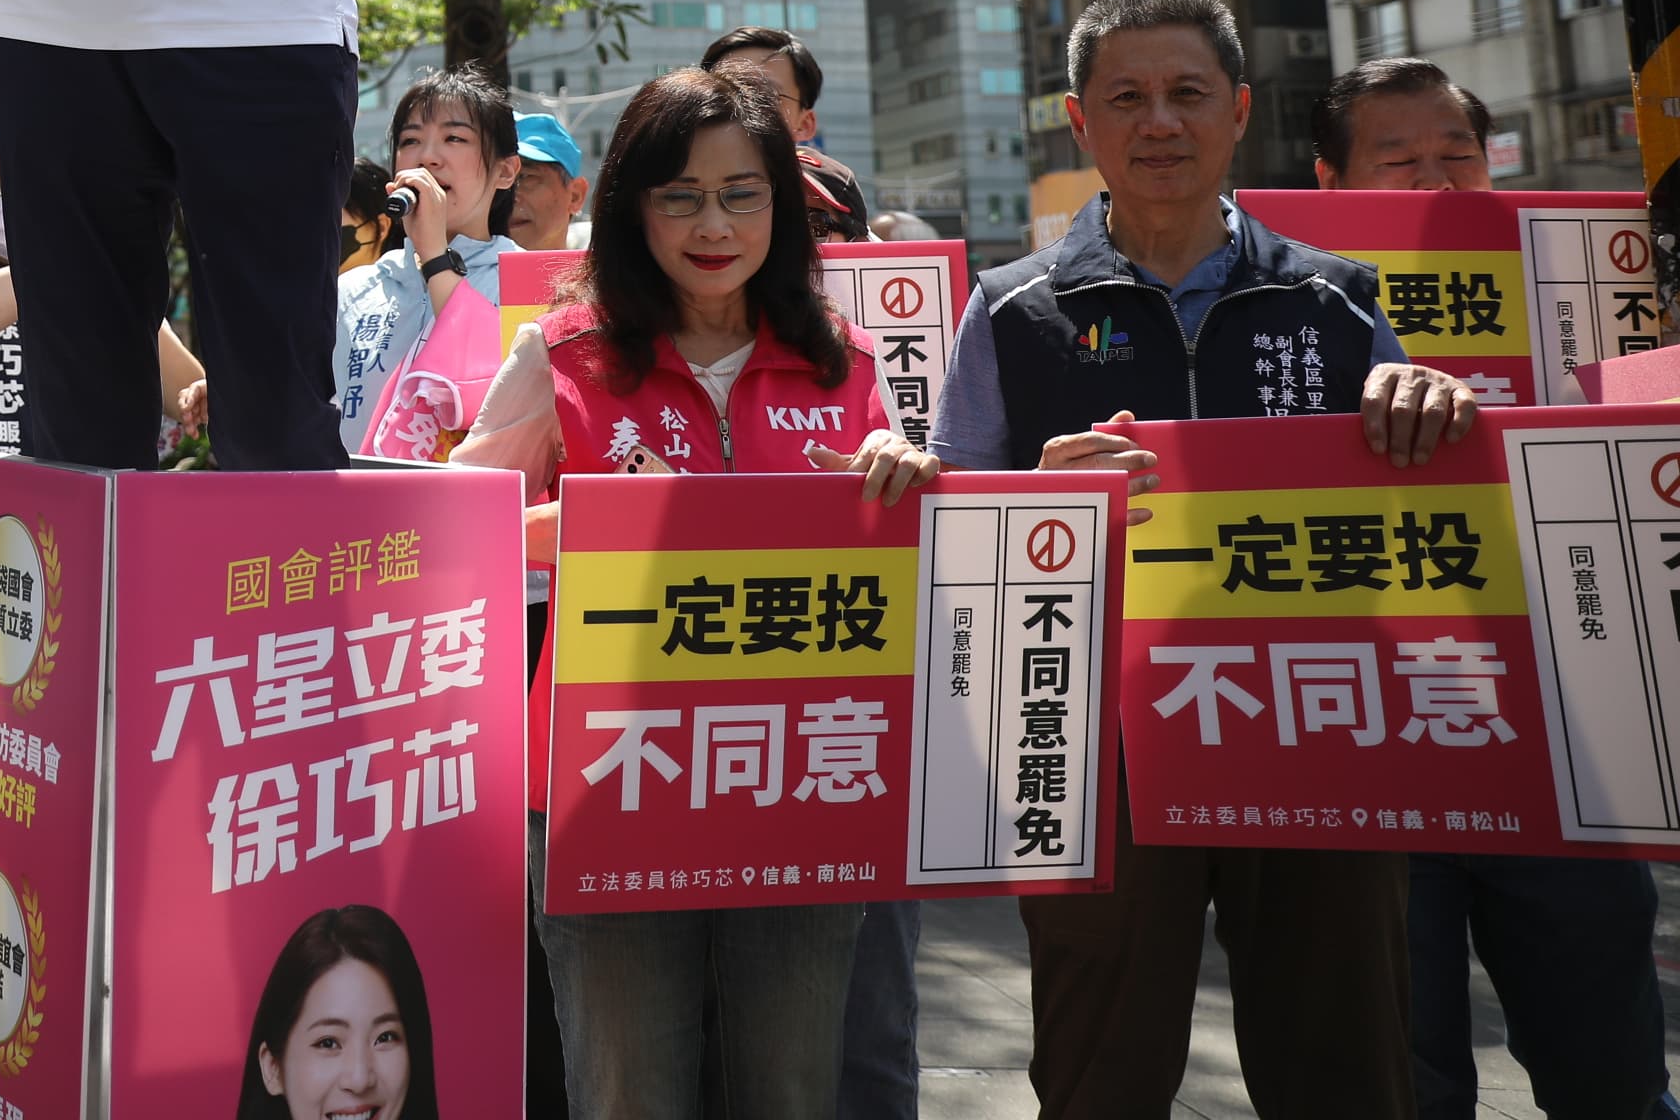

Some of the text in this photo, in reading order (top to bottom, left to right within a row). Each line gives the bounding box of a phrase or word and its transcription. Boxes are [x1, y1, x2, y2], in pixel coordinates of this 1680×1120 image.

[1386, 272, 1507, 336] 要投
[1557, 301, 1578, 375] 同意罷免
[1253, 333, 1276, 405] 總幹事
[1275, 336, 1299, 406] 副會長兼
[1298, 326, 1327, 415] 信義區里
[659, 405, 691, 473] 松山
[766, 405, 845, 431] KMT
[225, 528, 421, 615] 國會評鑑
[1132, 511, 1488, 594] 一定要投
[1568, 546, 1607, 640] 同意罷免
[583, 574, 888, 656] 一定要投
[951, 607, 973, 697] 同意罷免
[152, 597, 488, 763] 六星立委
[1148, 636, 1518, 748] 不同意
[580, 695, 889, 812] 不同意
[1014, 594, 1074, 858] 不同意罷免
[206, 719, 479, 894] 徐巧芯
[1165, 805, 1343, 828] 立法委員徐巧芯
[578, 866, 734, 894] 立法委員徐巧芯
